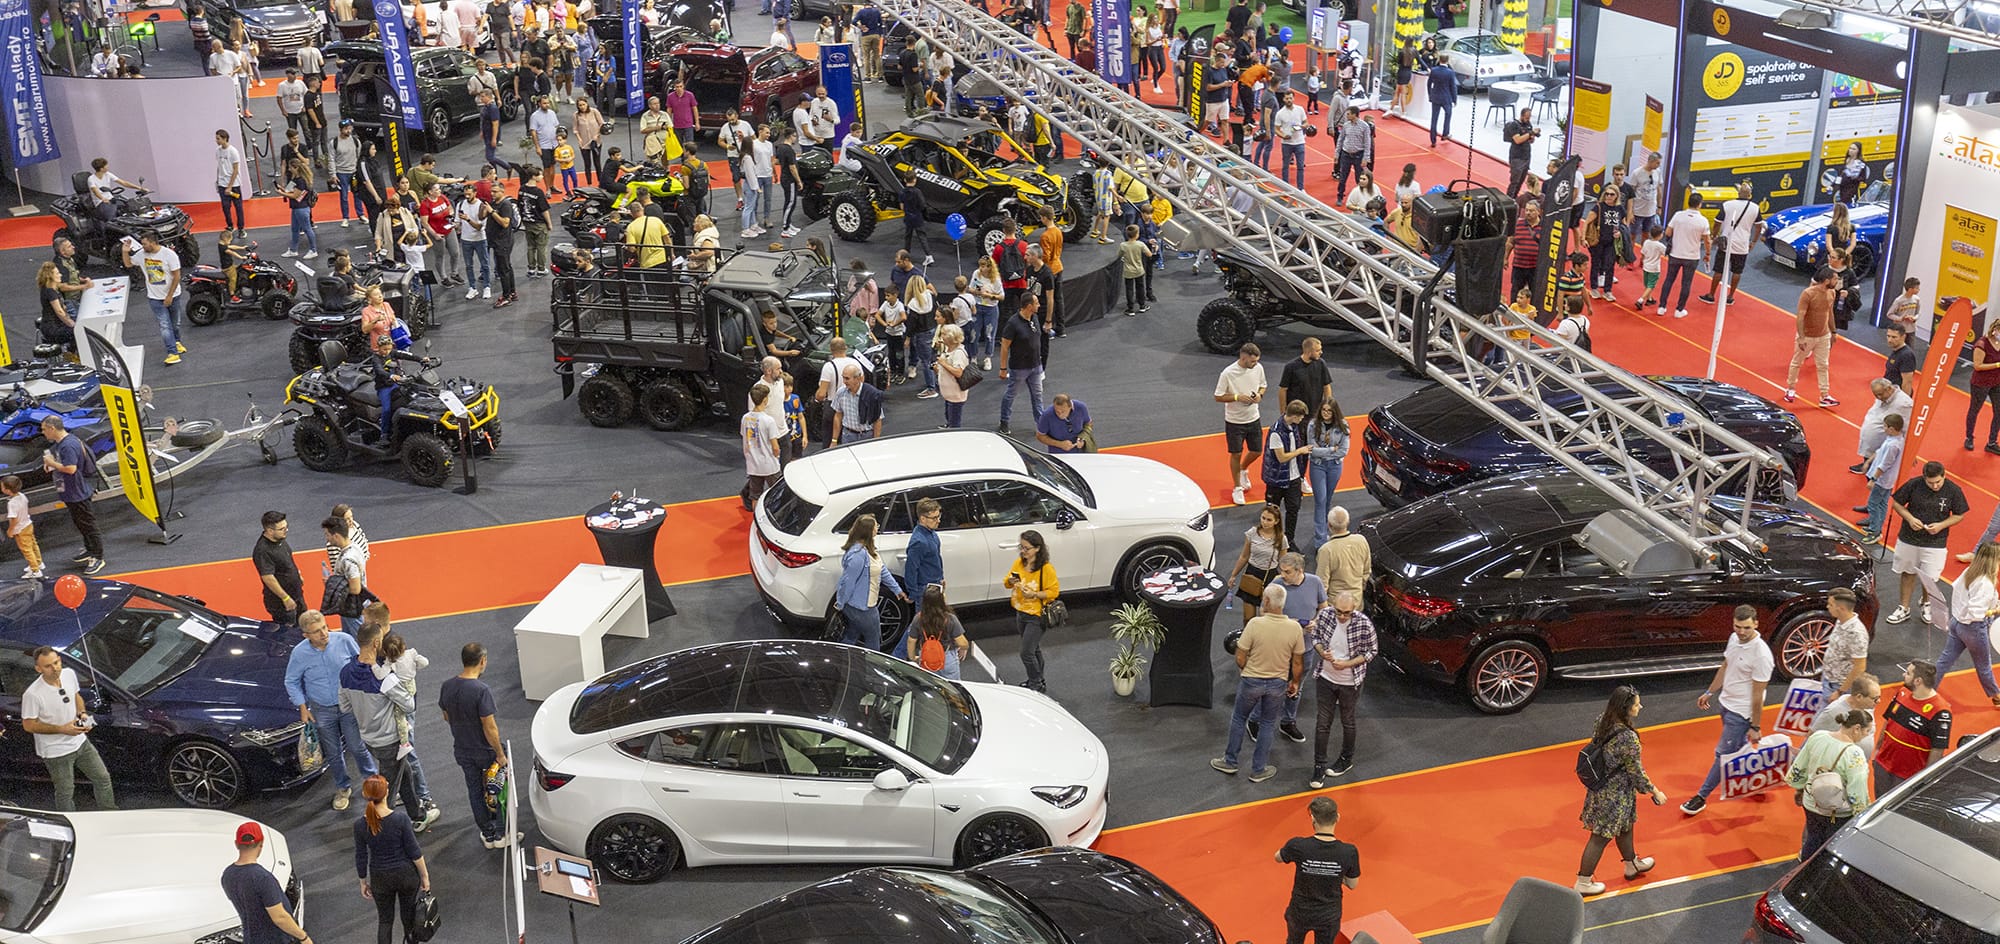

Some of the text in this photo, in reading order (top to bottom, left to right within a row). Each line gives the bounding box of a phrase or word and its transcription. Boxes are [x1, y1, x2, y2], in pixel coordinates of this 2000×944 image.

[0, 9, 28, 21] UBARU
[628, 7, 639, 88] SUBARU
[1714, 62, 1735, 79] JD
[1744, 71, 1806, 86] self service
[1746, 60, 1797, 76] spalatorie
[7, 35, 39, 158] SMT Pallady
[1190, 61, 1203, 126] can-am
[914, 168, 962, 193] can-am
[1958, 216, 1987, 233] atas
[1543, 219, 1564, 313] can-am
[1928, 353, 1948, 399] AUTO
[1945, 321, 1960, 349] BIG
[1789, 690, 1823, 709] LIQ
[1781, 710, 1816, 731] MO
[1727, 744, 1788, 777] LIQUI
[1727, 763, 1788, 797] MOLY
